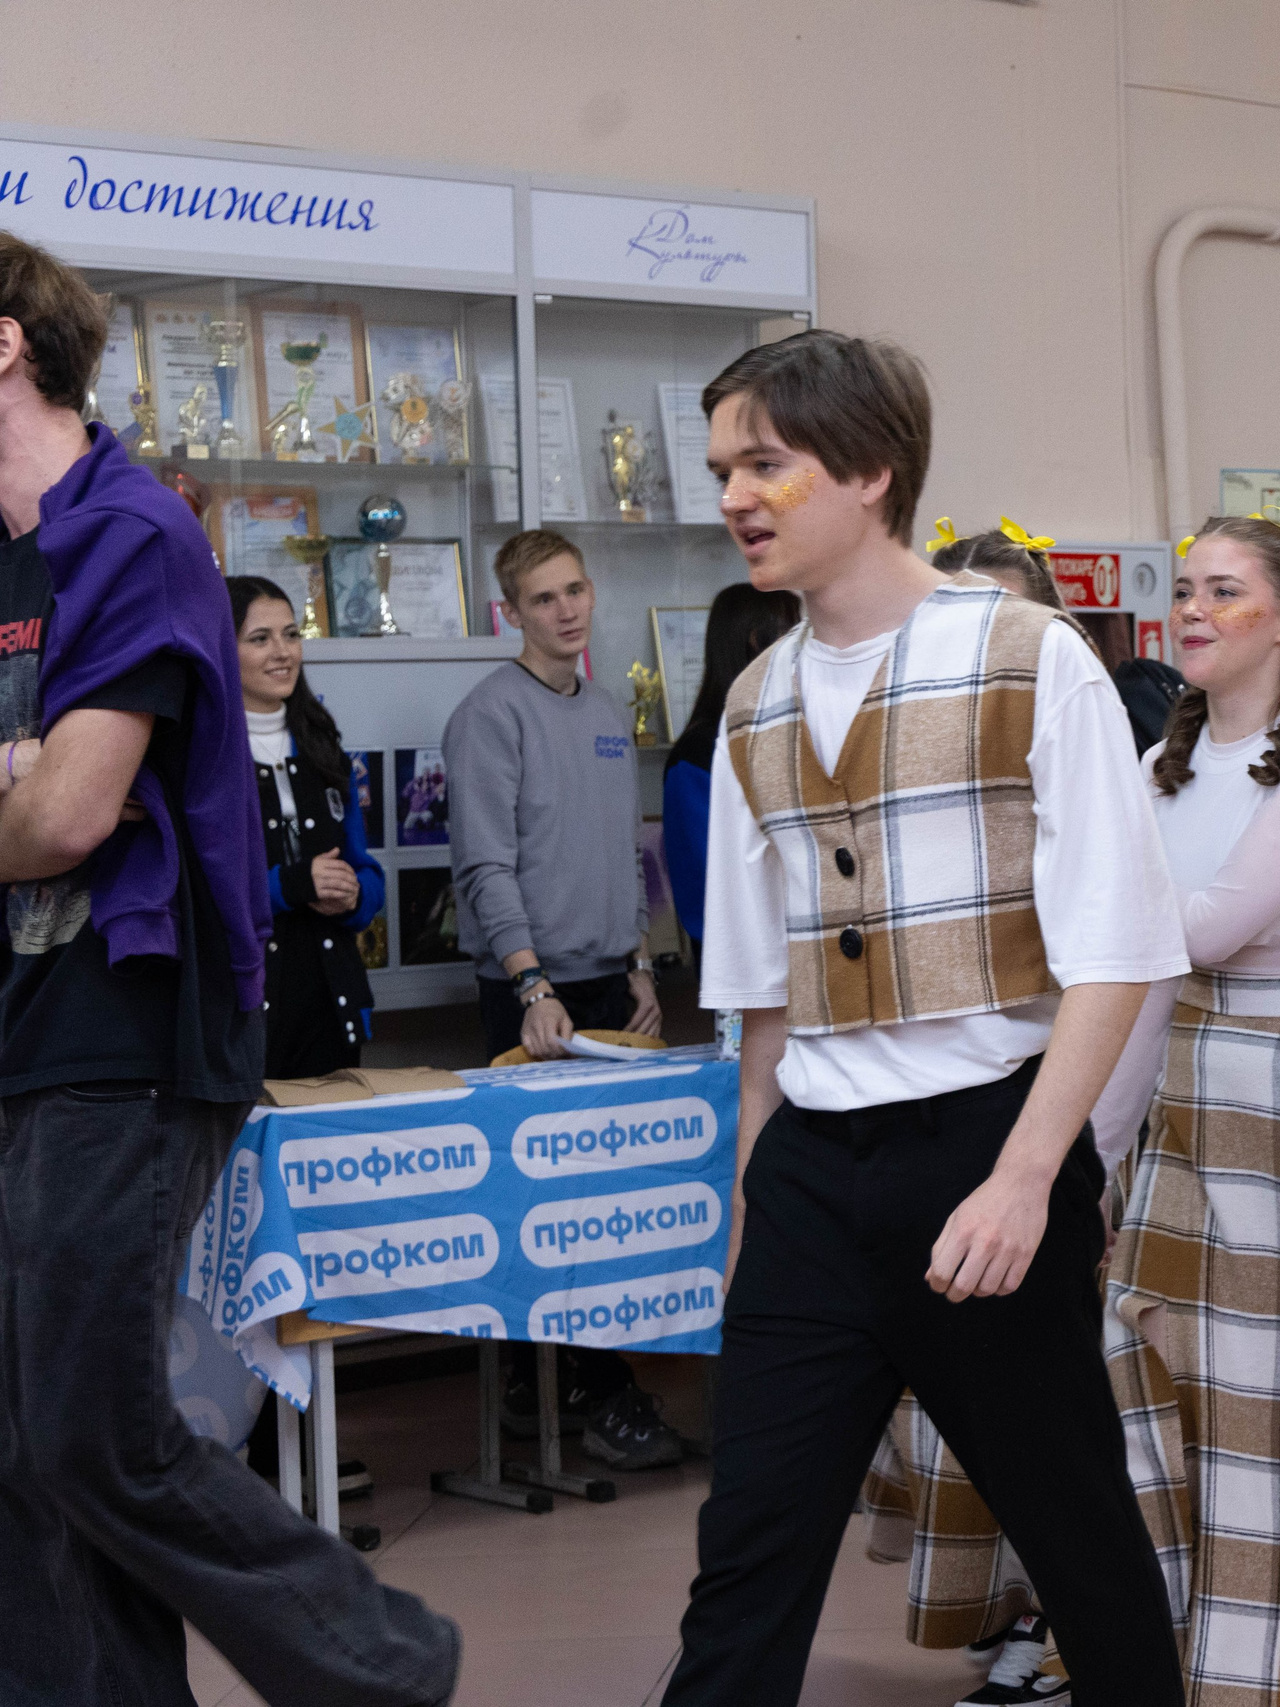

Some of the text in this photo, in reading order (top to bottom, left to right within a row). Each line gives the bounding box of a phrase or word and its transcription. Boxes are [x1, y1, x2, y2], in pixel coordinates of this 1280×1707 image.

[64, 155, 379, 232] достижения
[526, 1114, 704, 1165] профком
[283, 1143, 476, 1194] профком
[533, 1200, 709, 1254] профком
[541, 1285, 716, 1342] профком
